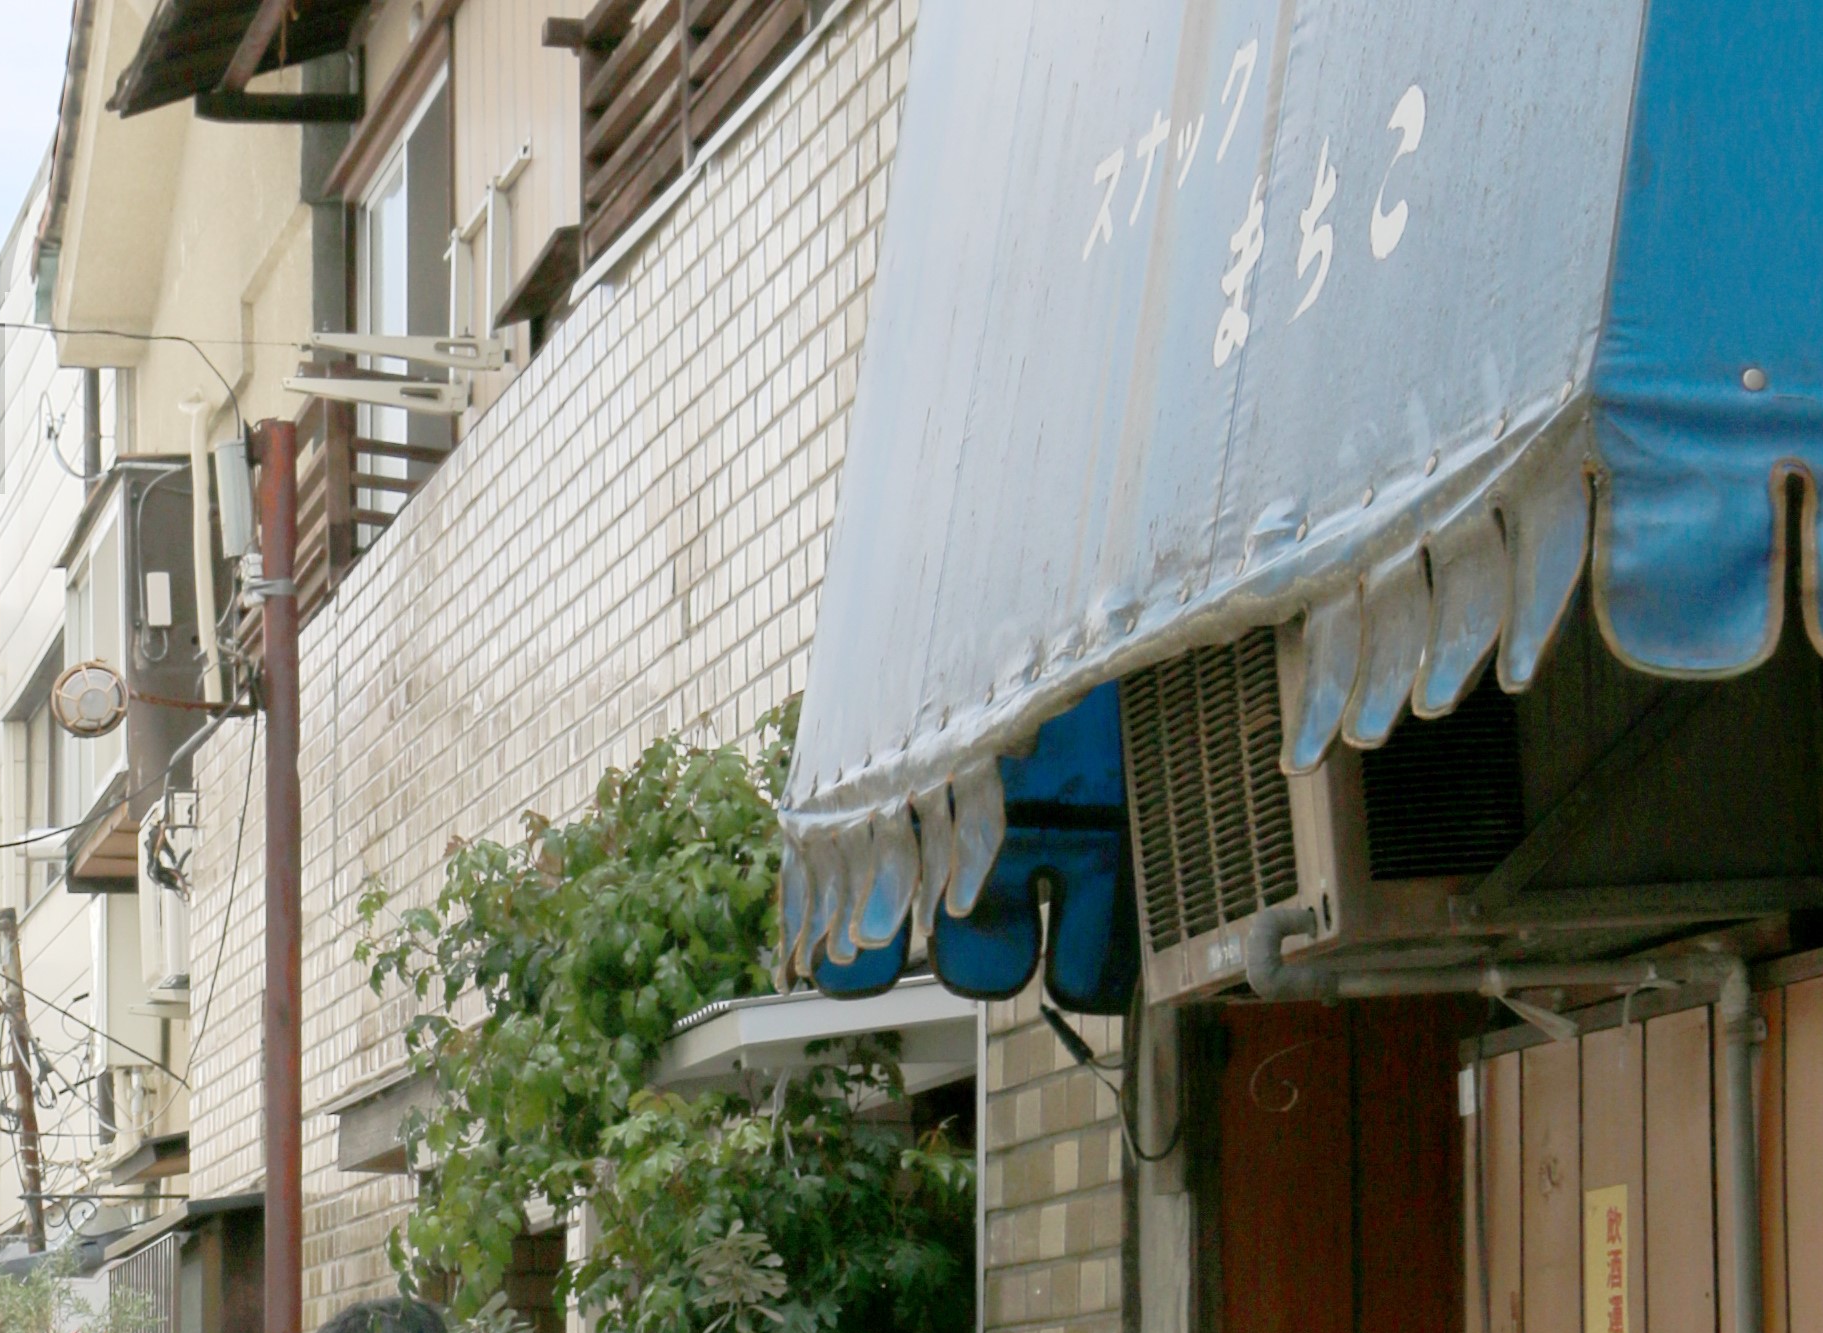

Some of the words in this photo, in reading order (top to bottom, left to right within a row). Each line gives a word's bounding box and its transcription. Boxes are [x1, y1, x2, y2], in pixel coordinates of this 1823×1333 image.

[1082, 37, 1259, 263] スナック
[1212, 83, 1428, 369] まちこ
